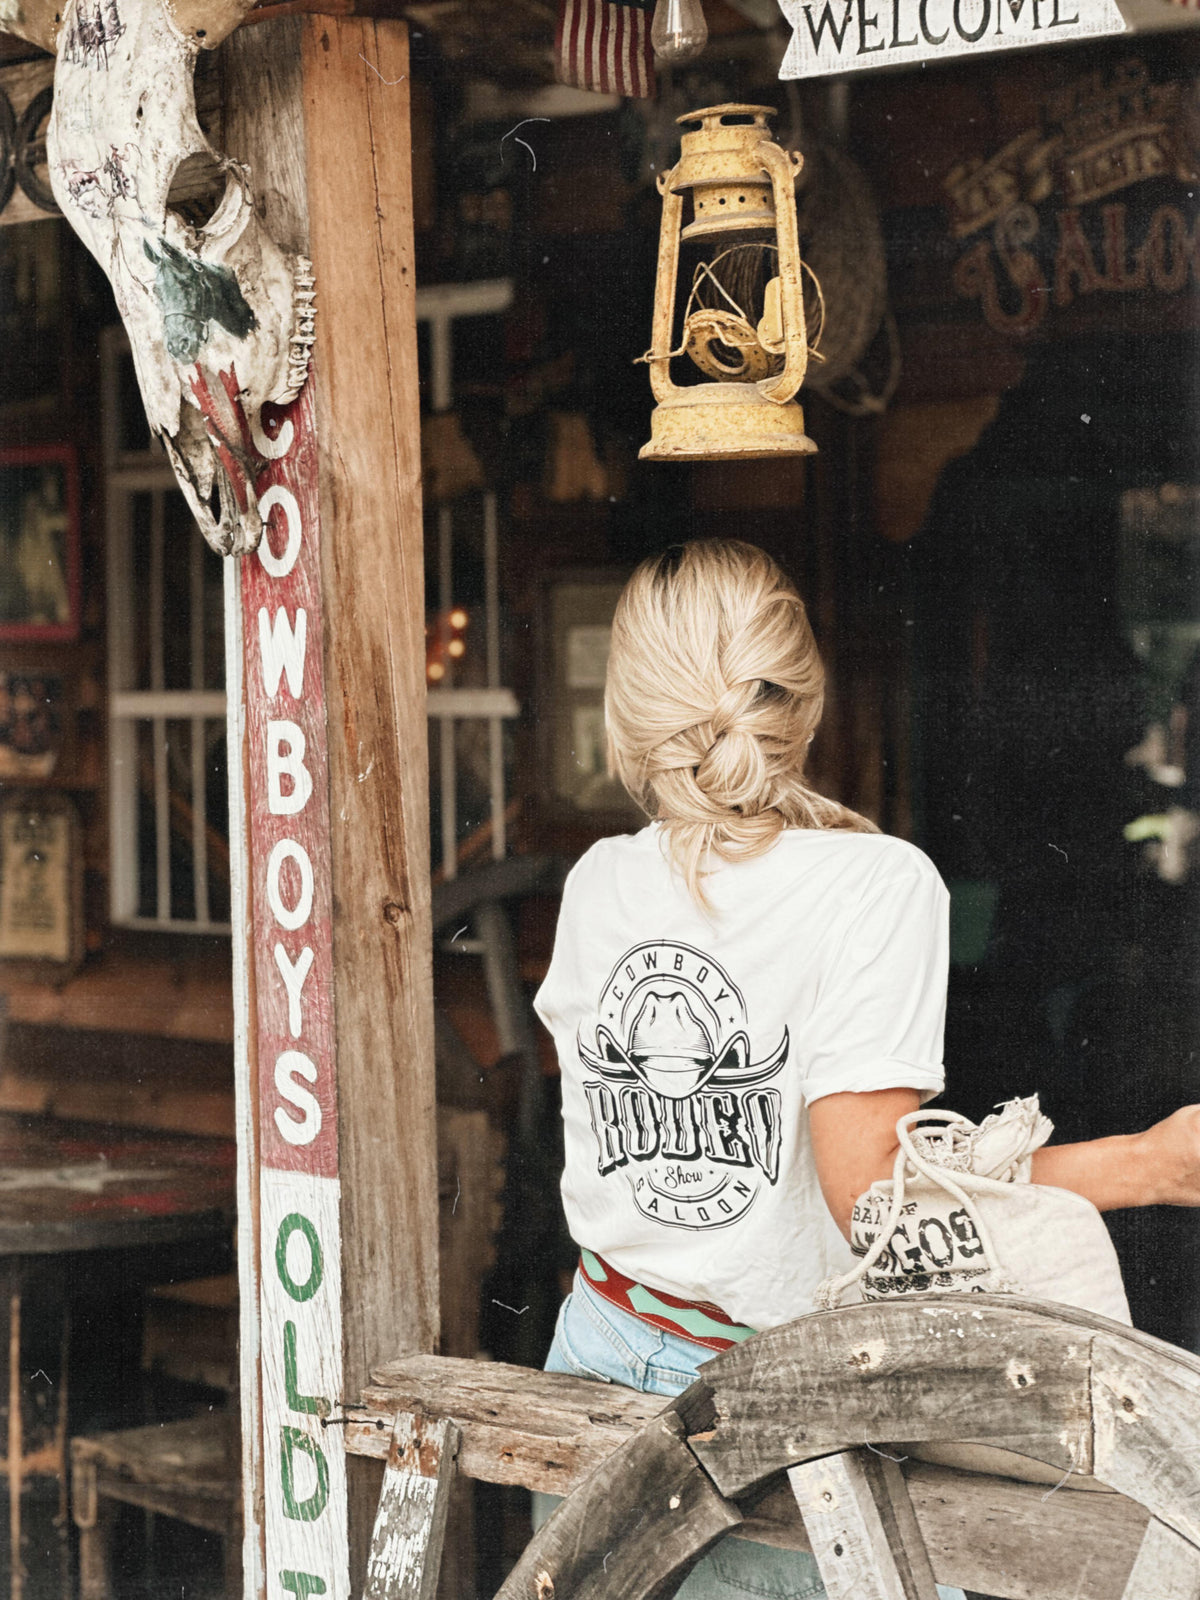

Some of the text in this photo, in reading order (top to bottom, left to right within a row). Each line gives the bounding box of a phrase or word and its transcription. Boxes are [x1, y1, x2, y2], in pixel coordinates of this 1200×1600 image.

[612, 951, 730, 1003] COWBOY
[583, 1080, 782, 1186] RODEO
[636, 1177, 751, 1222] SALOON
[664, 1165, 703, 1190] Show
[275, 1211, 332, 1522] OLD
